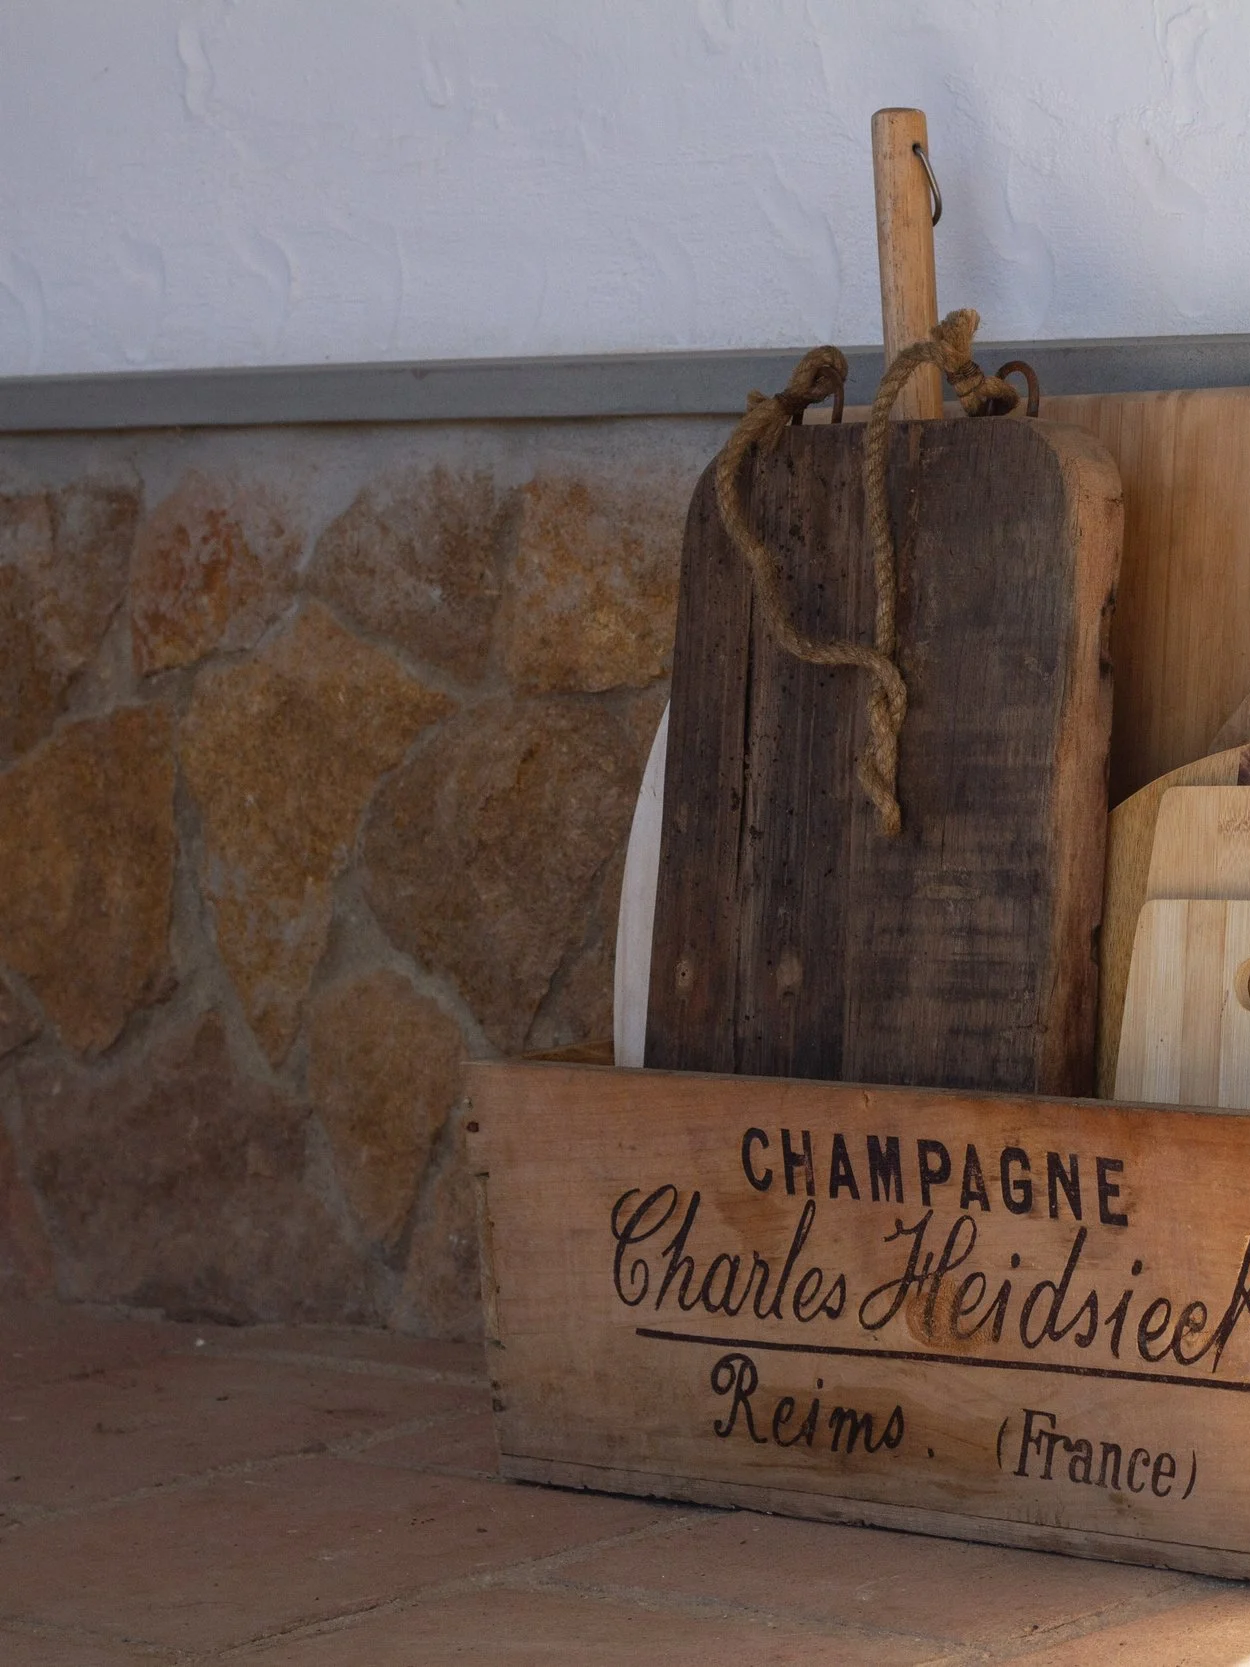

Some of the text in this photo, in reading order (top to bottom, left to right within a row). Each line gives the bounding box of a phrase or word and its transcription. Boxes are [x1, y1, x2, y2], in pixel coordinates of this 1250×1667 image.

[742, 1127, 1128, 1226] CHAMPAGNE
[611, 1184, 848, 1322] Charles
[996, 1408, 1197, 1499] (France)
